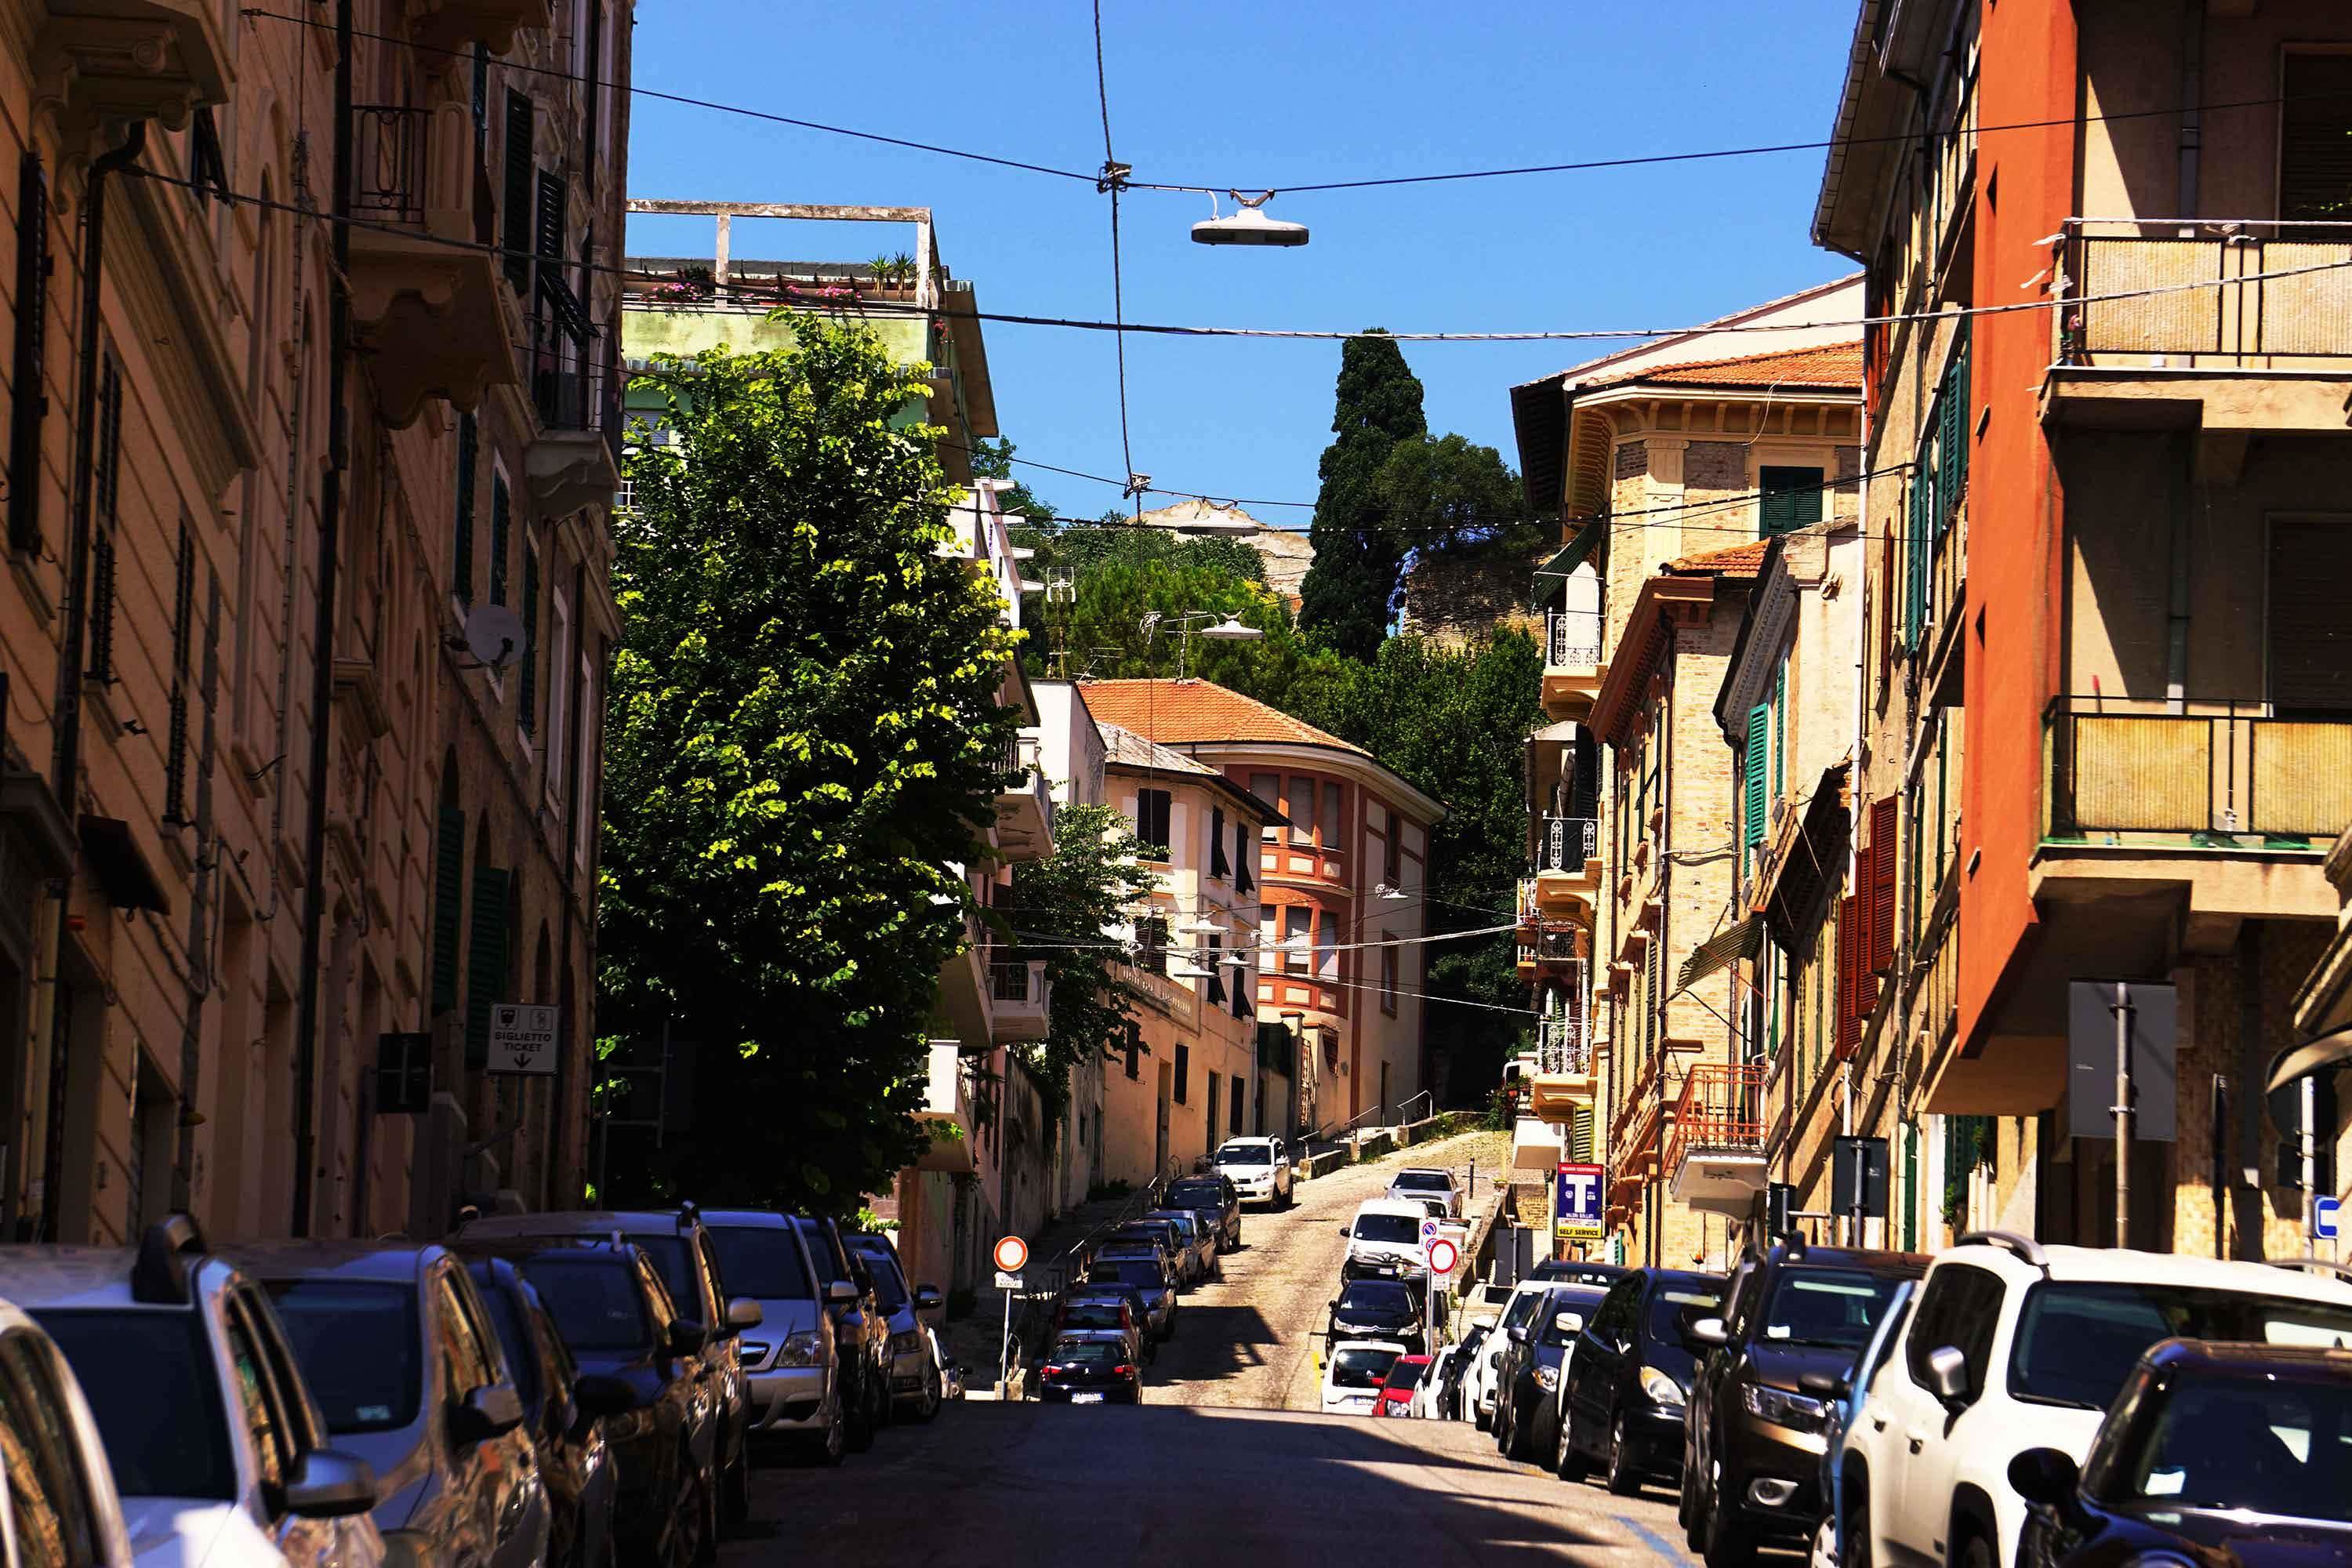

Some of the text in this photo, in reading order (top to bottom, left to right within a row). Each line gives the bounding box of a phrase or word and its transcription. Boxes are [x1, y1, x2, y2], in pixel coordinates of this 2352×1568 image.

[495, 1032, 551, 1042] BIGLIETTO
[503, 1043, 542, 1052] TICKET
[1566, 1174, 1595, 1213] T
